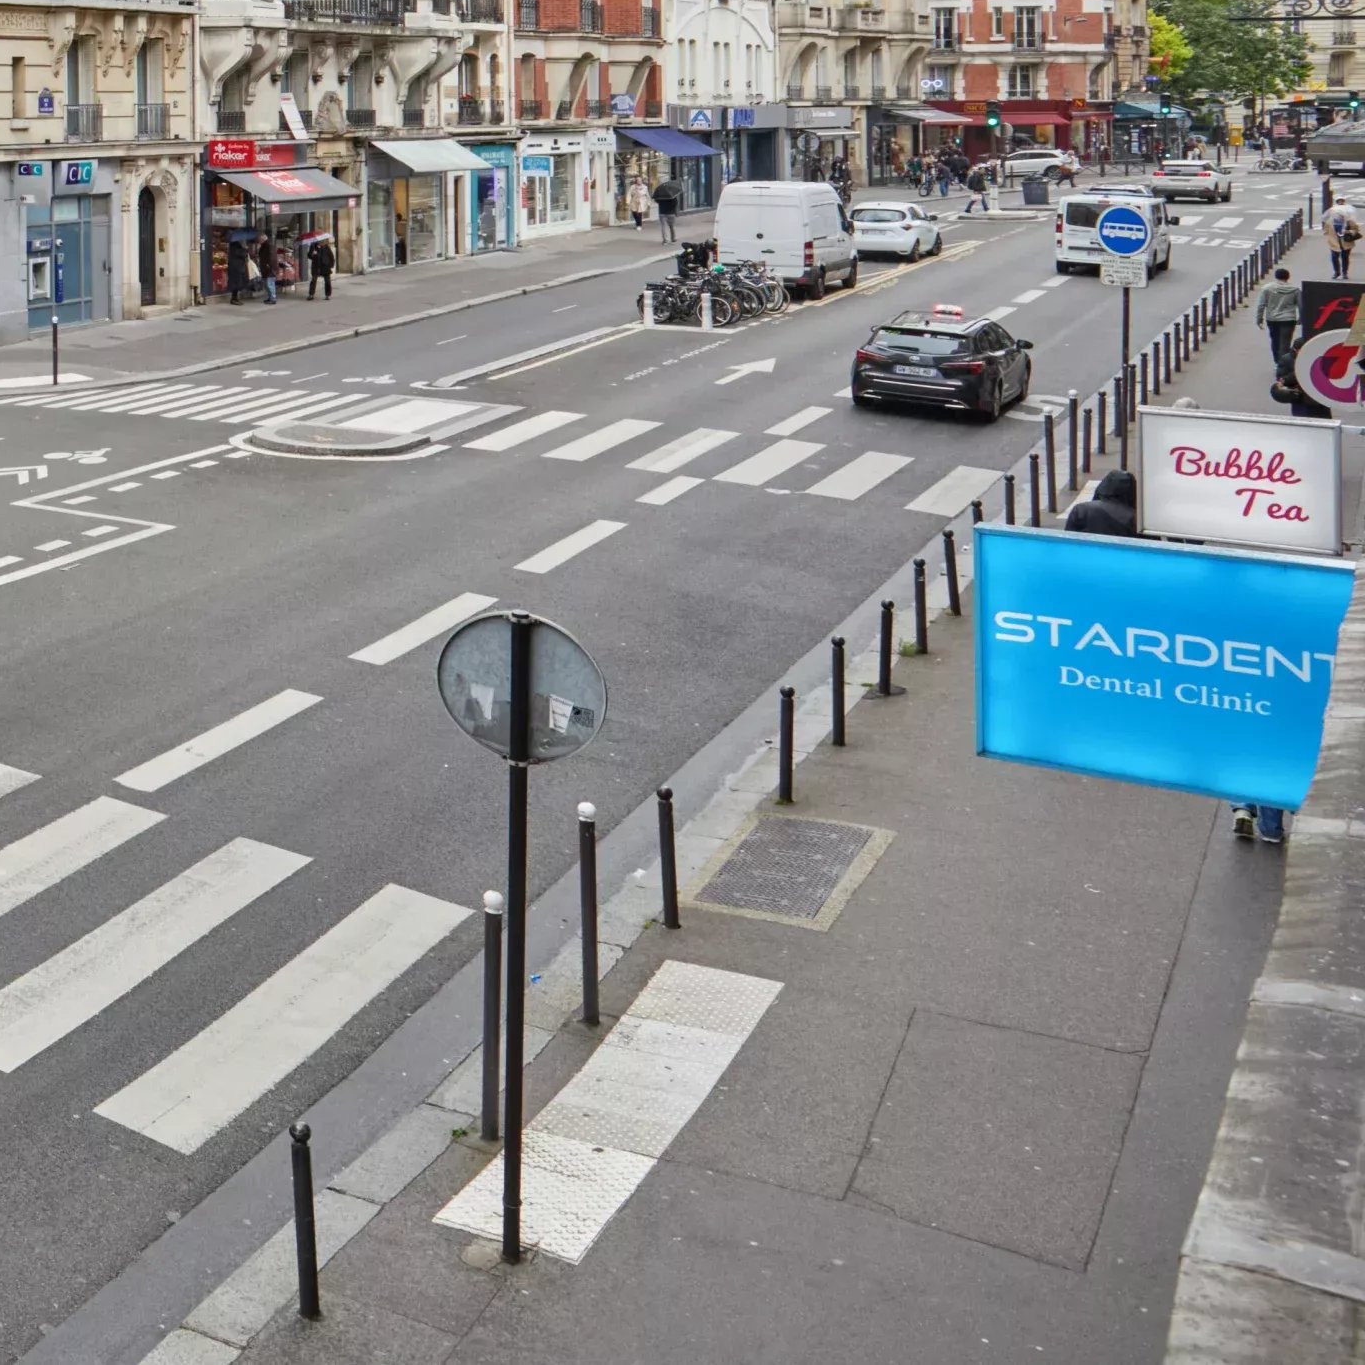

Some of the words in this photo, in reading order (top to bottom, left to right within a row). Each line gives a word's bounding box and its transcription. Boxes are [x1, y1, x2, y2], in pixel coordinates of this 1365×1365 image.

[212, 150, 248, 160] rieker
[69, 166, 90, 182] CIC
[1170, 446, 1303, 486] Bubble
[1235, 488, 1310, 522] Tea
[994, 610, 1336, 683] STARDENT
[1059, 666, 1163, 700] Dental
[1174, 683, 1272, 717] Clinic
